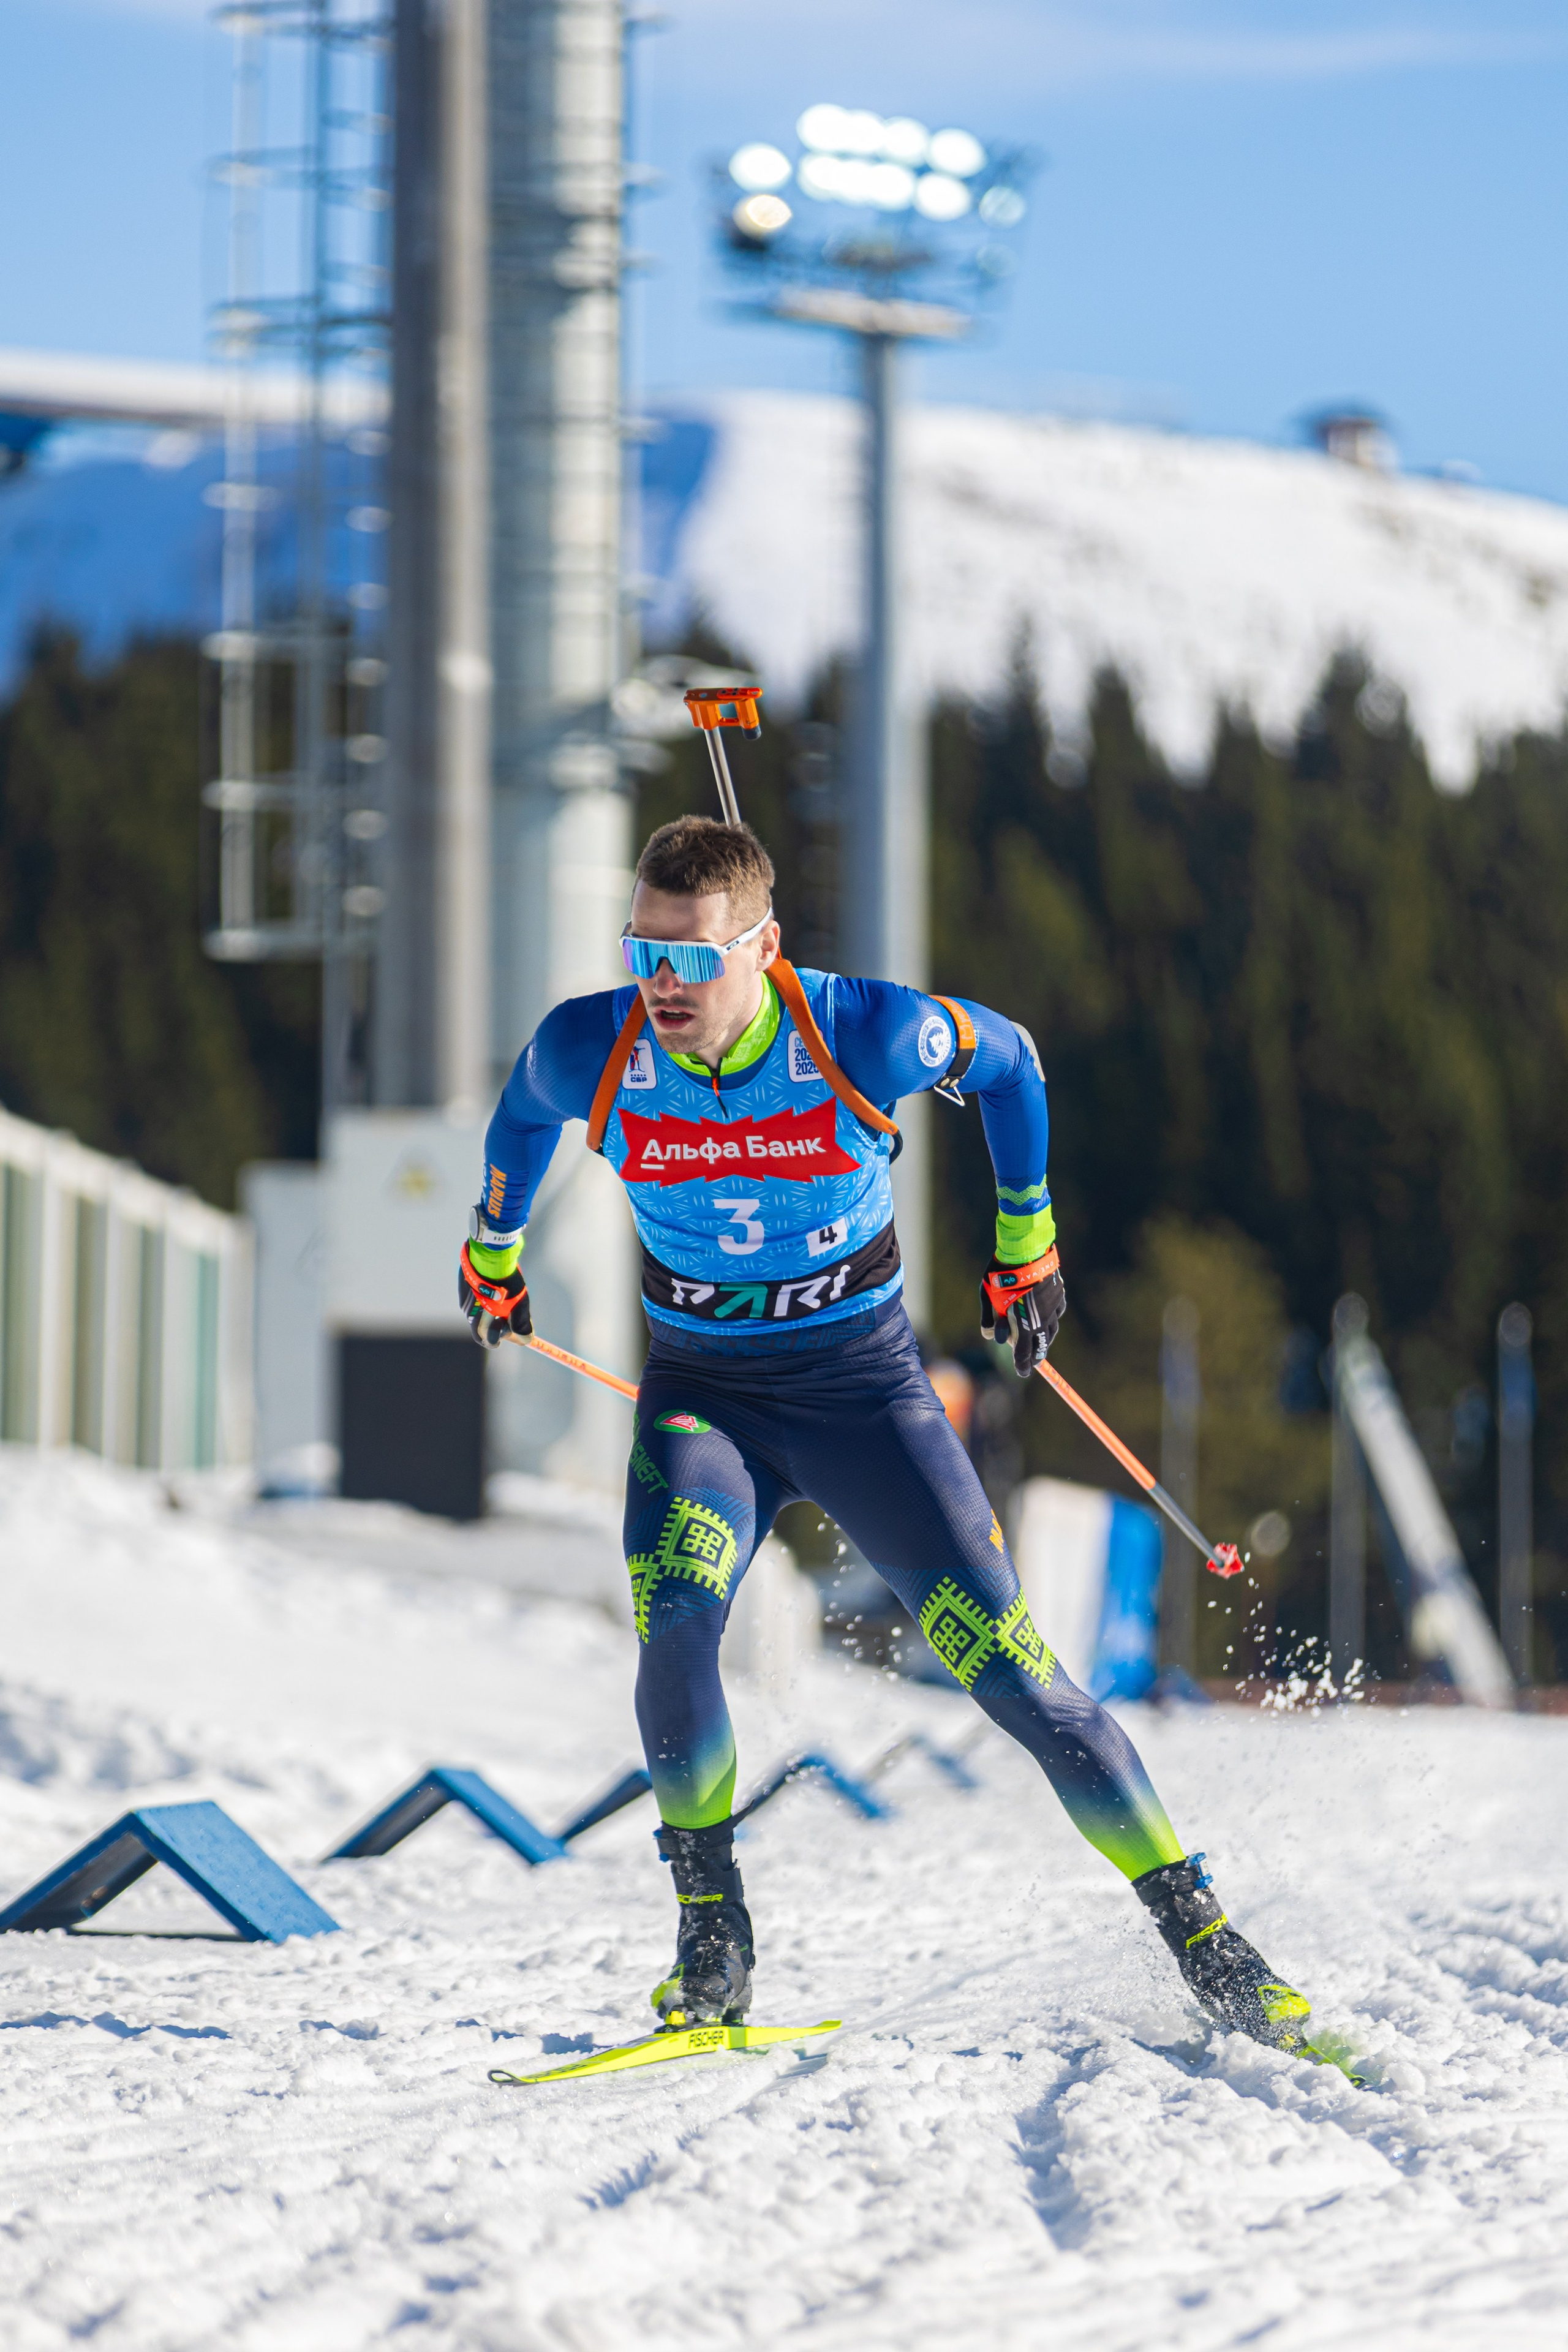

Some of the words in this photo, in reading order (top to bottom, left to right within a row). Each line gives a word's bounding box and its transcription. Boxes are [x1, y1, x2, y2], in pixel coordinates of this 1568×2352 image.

[794, 1047, 812, 1061] 202
[641, 1137, 741, 1164] Альфа
[745, 1136, 826, 1158] Банк
[488, 1163, 507, 1218] MAPLUS
[712, 1198, 765, 1255] 3
[819, 1225, 837, 1244] 4
[1020, 1261, 1054, 1283] ONE/WAY
[671, 1264, 851, 1318] PARI
[688, 2030, 724, 2049] FISCHER
